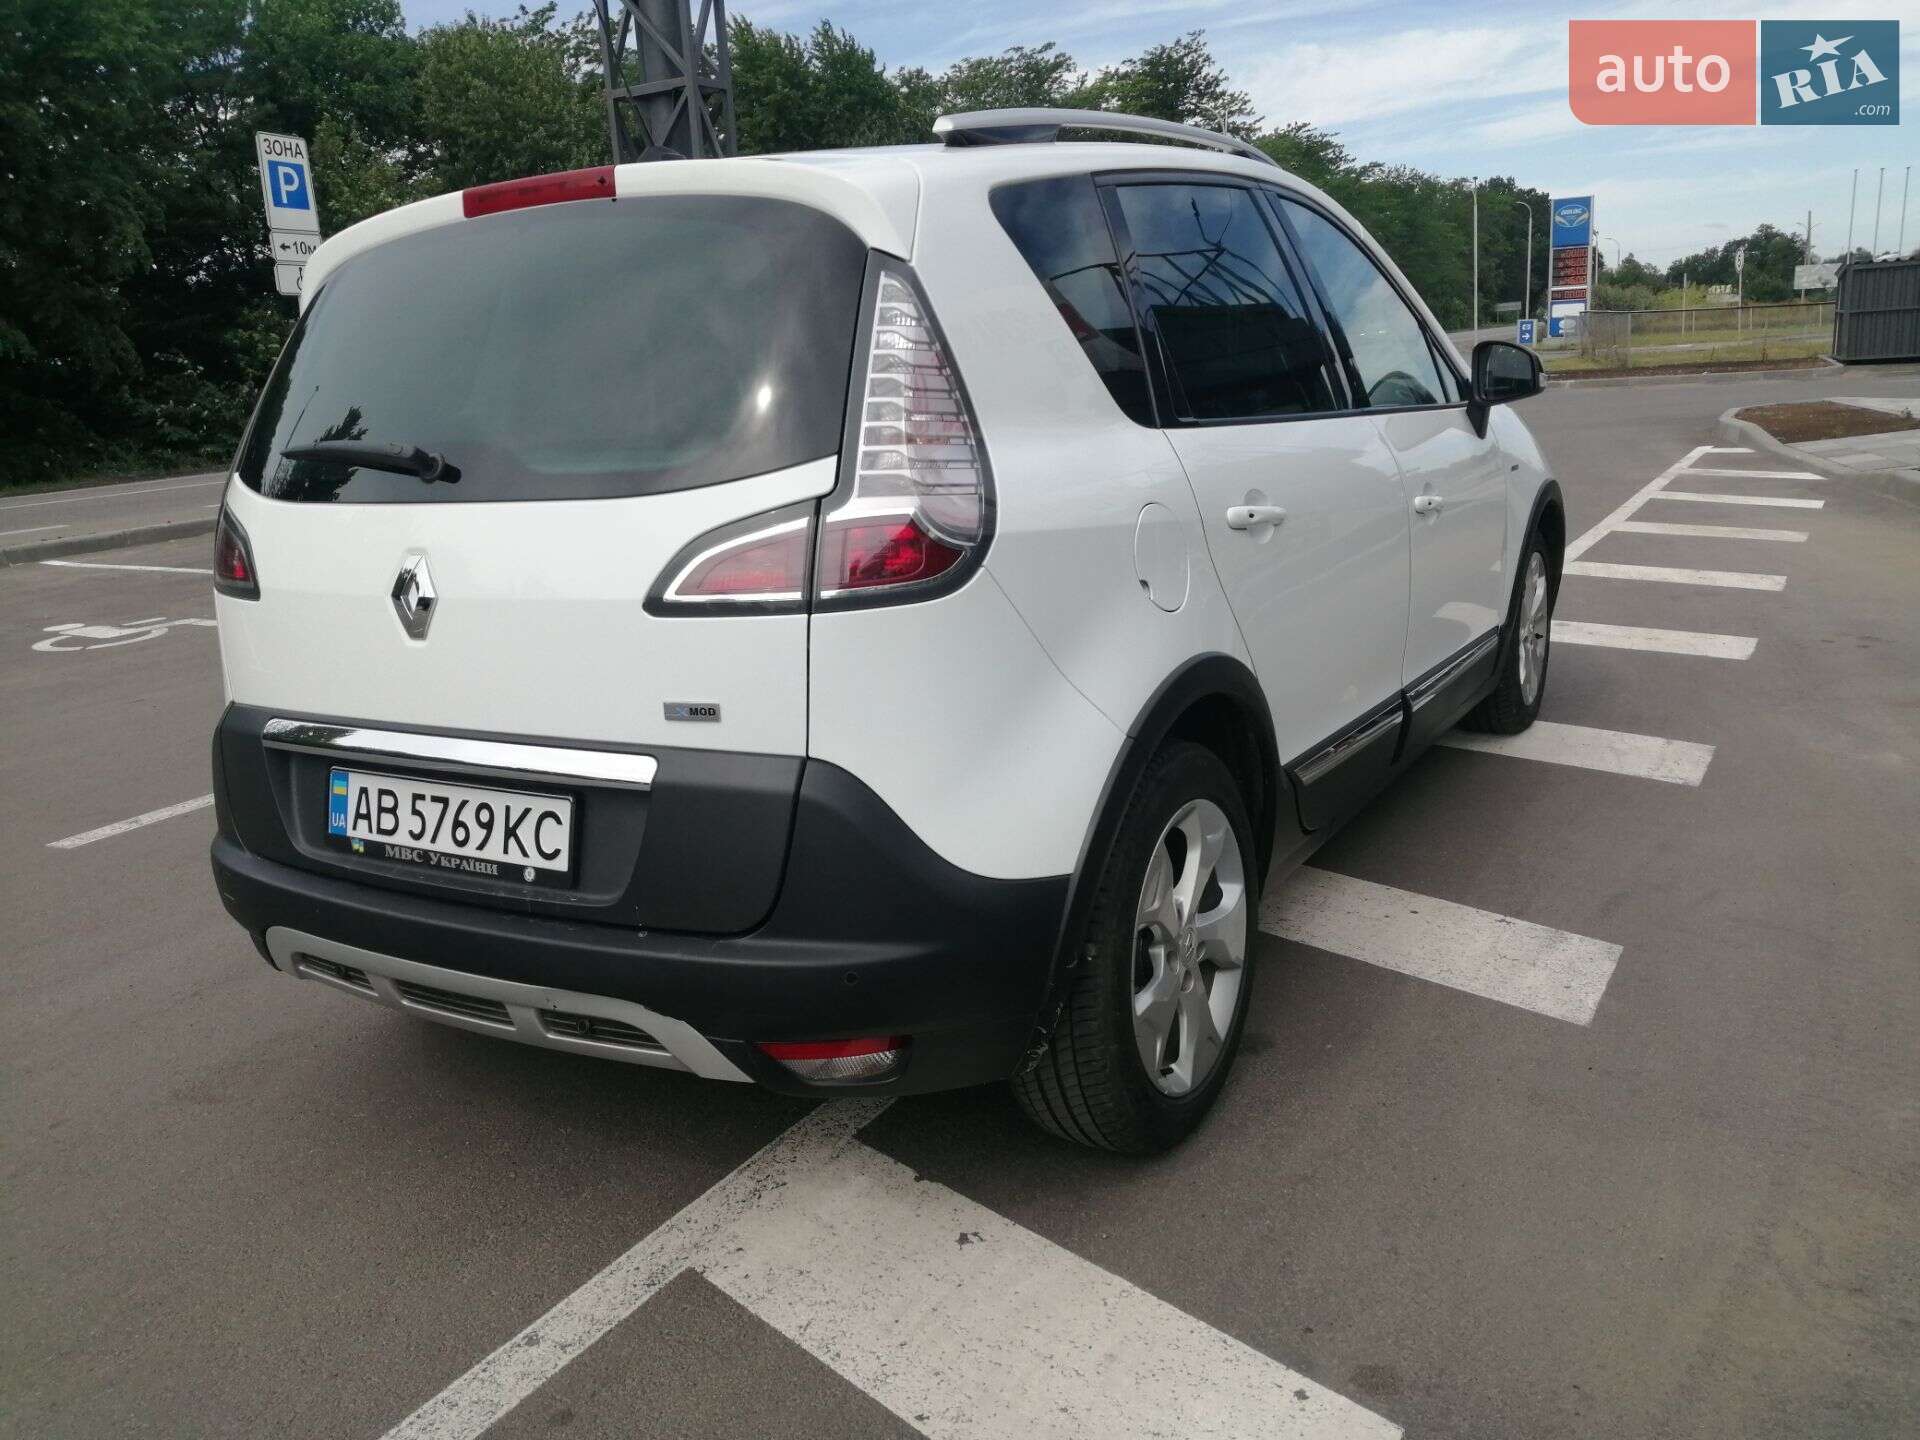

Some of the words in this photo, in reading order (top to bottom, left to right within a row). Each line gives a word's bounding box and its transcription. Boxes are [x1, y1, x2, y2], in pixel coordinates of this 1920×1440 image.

[263, 138, 304, 159] ЗОНА
[277, 165, 300, 204] P
[332, 811, 346, 829] UA
[352, 786, 400, 836] AB
[408, 793, 495, 851] 5769
[384, 845, 425, 863] МВС
